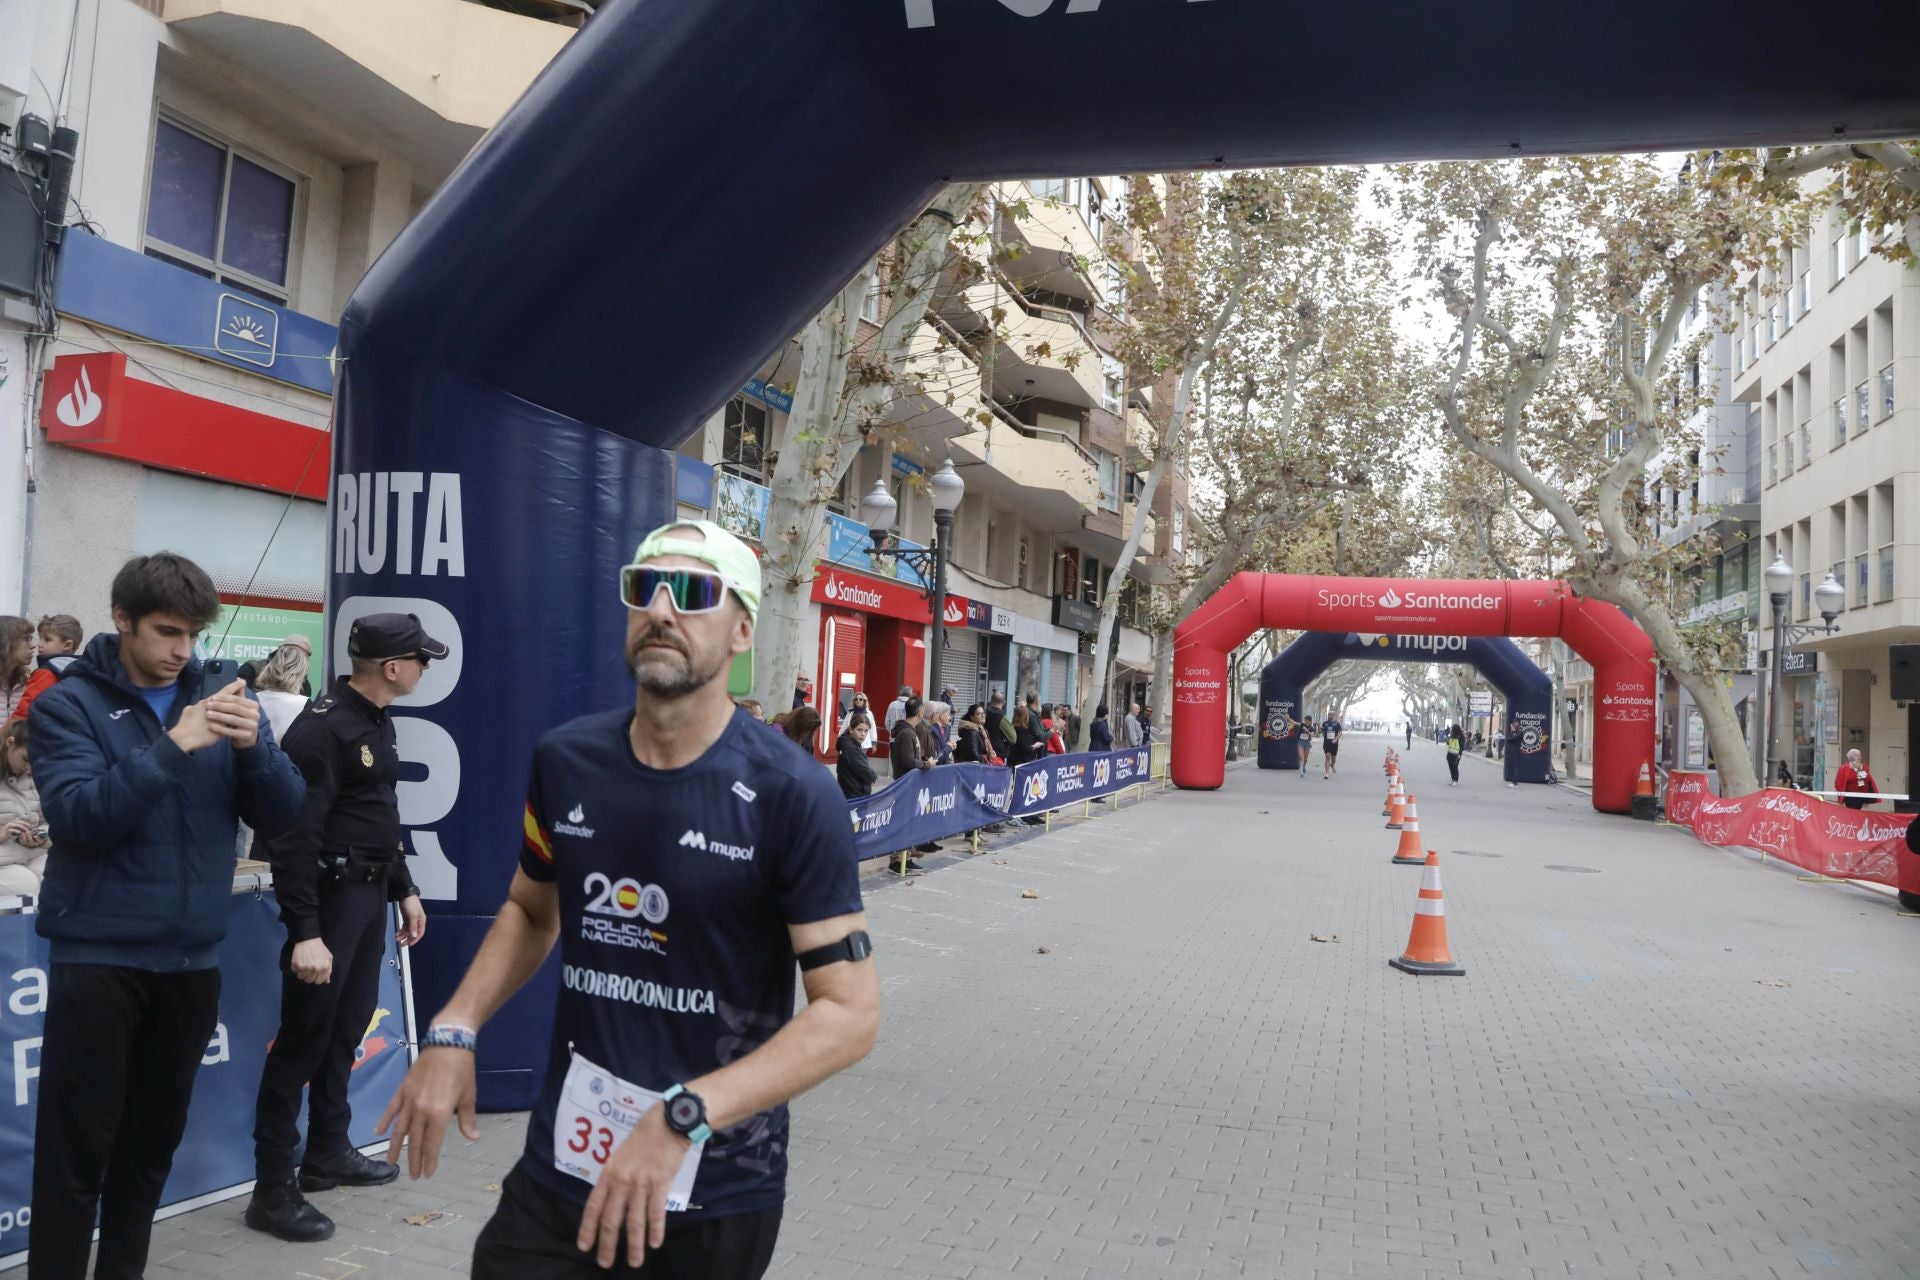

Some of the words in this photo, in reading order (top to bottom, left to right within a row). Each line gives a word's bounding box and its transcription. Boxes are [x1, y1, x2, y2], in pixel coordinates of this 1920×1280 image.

[336, 471, 465, 577] RUTA
[838, 581, 882, 609] Santander
[1318, 589, 1375, 611] Sports
[1405, 592, 1502, 610] Santander
[1375, 615, 1436, 623] sportssantander.es
[1397, 634, 1467, 654] mupol
[1784, 651, 1804, 670] ebeca
[1184, 666, 1211, 677] Sports
[1182, 680, 1221, 689] Santander
[1616, 682, 1644, 692] Sports
[1269, 706, 1289, 714] mupol
[1515, 711, 1547, 720] fundación
[1520, 719, 1541, 727] mupol
[1093, 757, 1111, 788] 200
[1136, 751, 1148, 776] 200
[1056, 777, 1084, 794] NACIONAL
[931, 786, 956, 816] mupol
[553, 820, 595, 839] Santander
[1826, 816, 1858, 840] Sports
[709, 840, 755, 861] mupol
[584, 872, 670, 924] 200
[582, 916, 653, 939] POLICIA
[581, 929, 667, 956] NACIONAL
